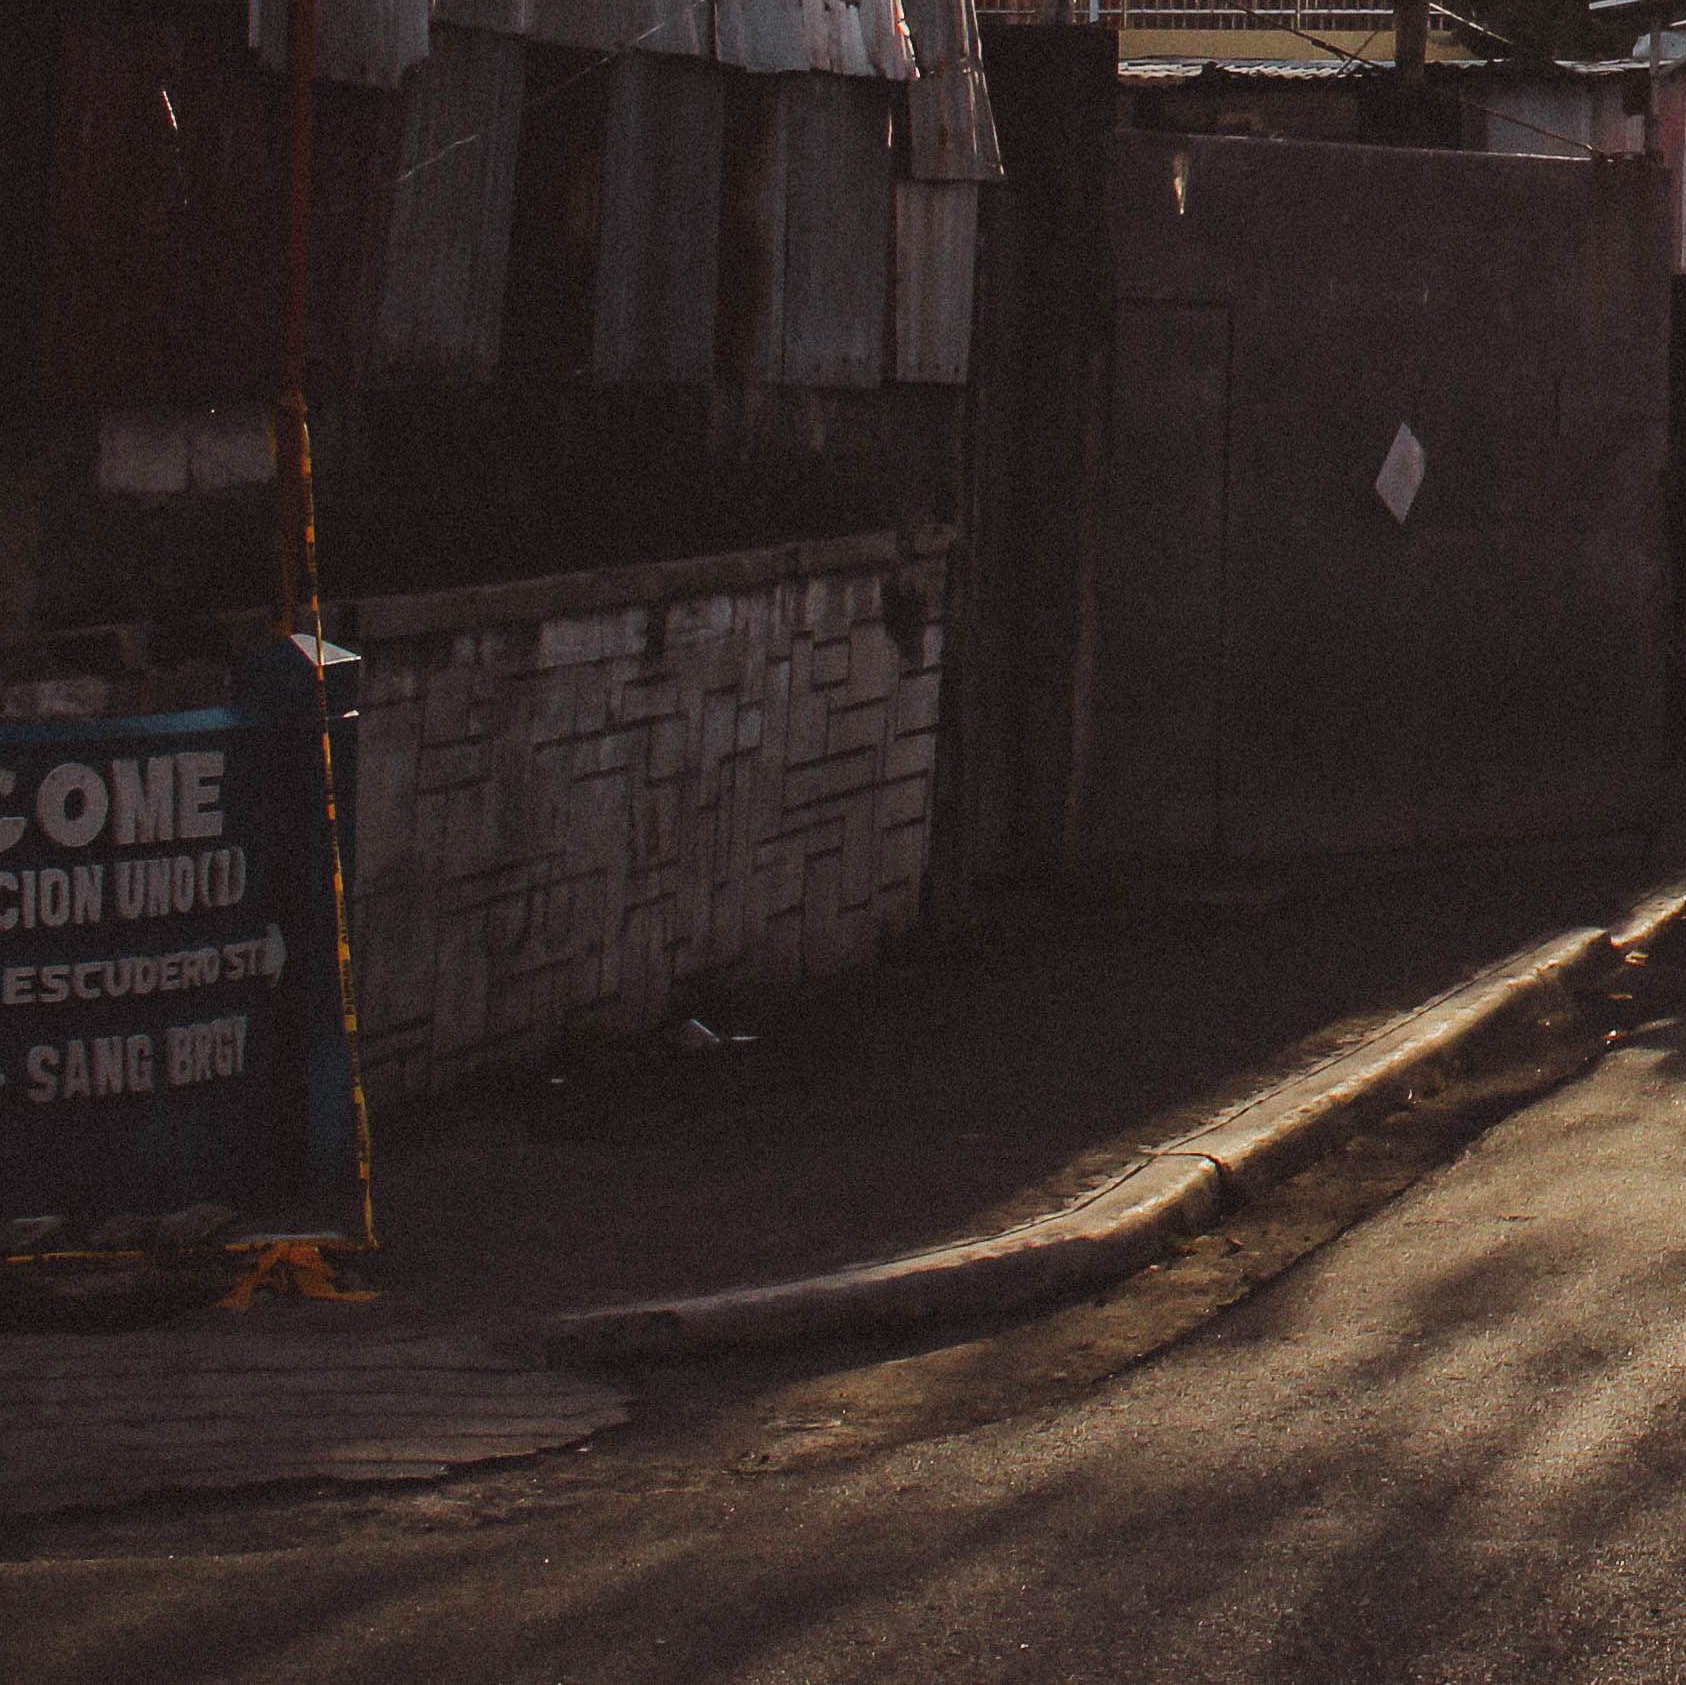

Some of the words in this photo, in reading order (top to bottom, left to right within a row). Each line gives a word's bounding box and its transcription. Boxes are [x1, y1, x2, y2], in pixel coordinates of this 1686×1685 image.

[0, 864, 103, 930] CION
[1, 947, 219, 1004] ESCUDERO
[27, 1034, 152, 1103] SANG
[166, 1016, 247, 1085] BRGY
